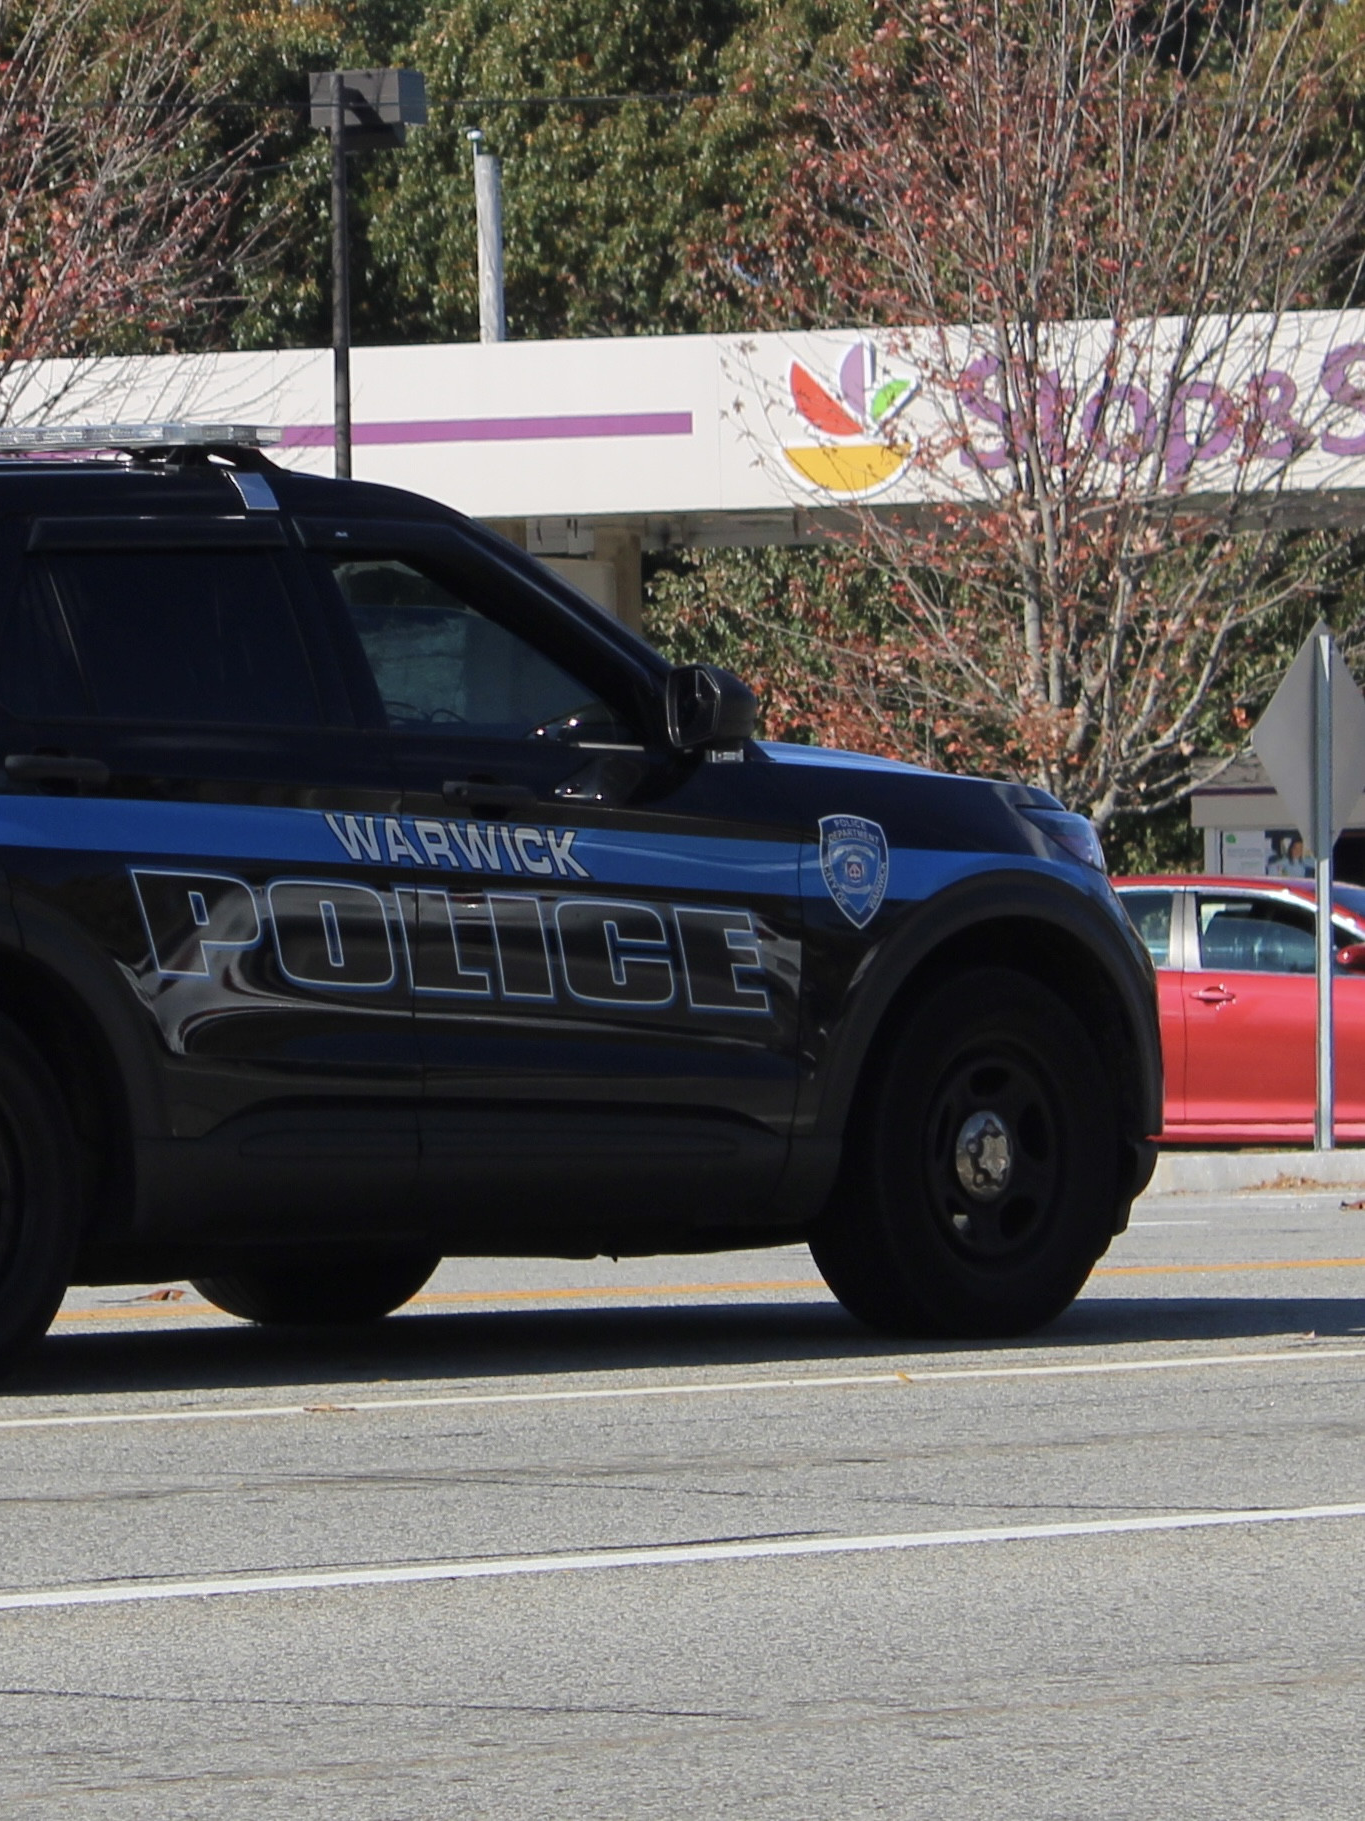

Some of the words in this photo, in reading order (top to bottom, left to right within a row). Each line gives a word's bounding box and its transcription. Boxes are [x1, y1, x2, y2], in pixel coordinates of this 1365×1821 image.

[324, 812, 591, 879] WARWICK
[828, 829, 880, 844] DEPARTMENT
[834, 818, 867, 831] POLICE
[868, 861, 887, 910] WARWICK
[126, 864, 772, 1018] POLICE
